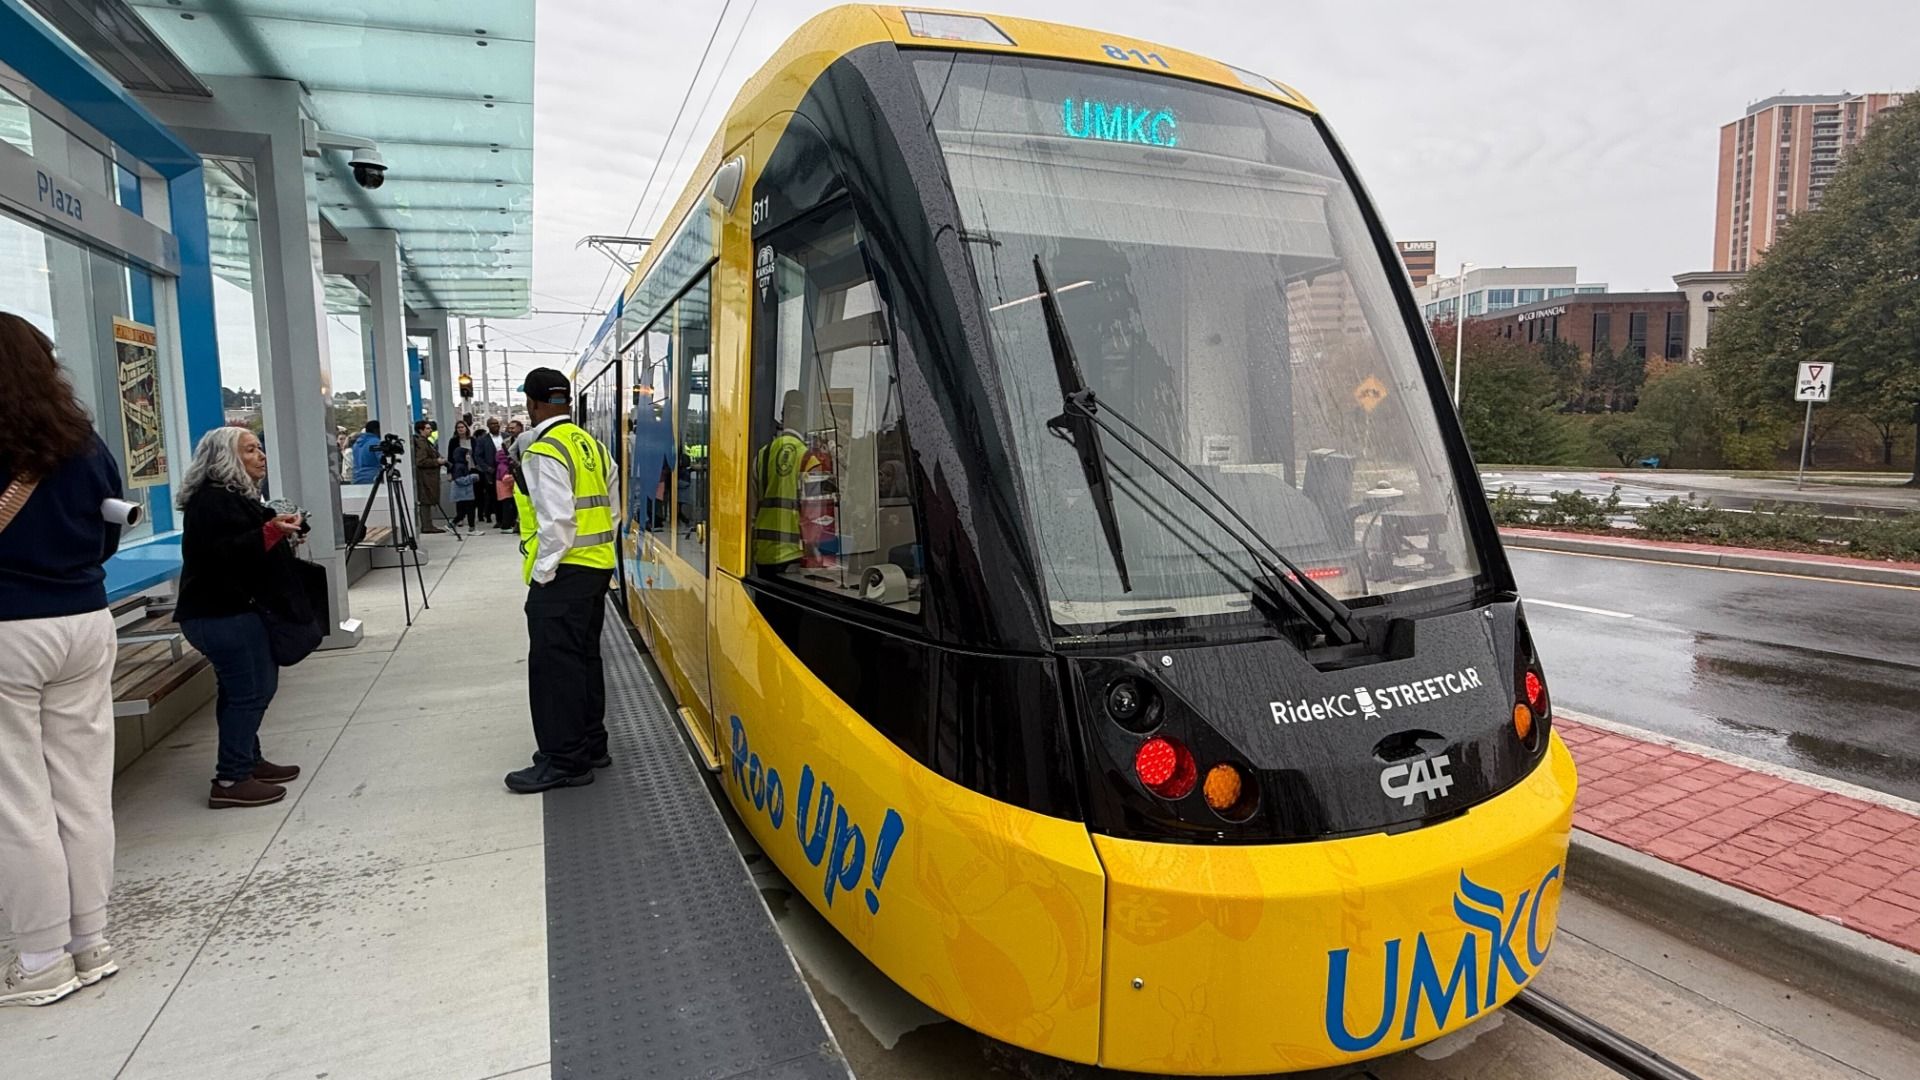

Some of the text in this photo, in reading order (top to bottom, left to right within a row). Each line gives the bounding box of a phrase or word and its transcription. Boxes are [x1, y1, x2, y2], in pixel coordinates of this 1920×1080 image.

[1101, 44, 1169, 69] 811
[1064, 97, 1177, 148] UMKC
[36, 170, 83, 222] Plaza
[753, 195, 769, 226] 811
[756, 262, 775, 279] KANSAS
[1403, 242, 1435, 250] UMB
[1270, 667, 1483, 725] RideKC STREETCAR
[1380, 754, 1454, 807] CAF
[730, 715, 904, 915] Roo Up!
[1325, 863, 1561, 1053] UMKC
